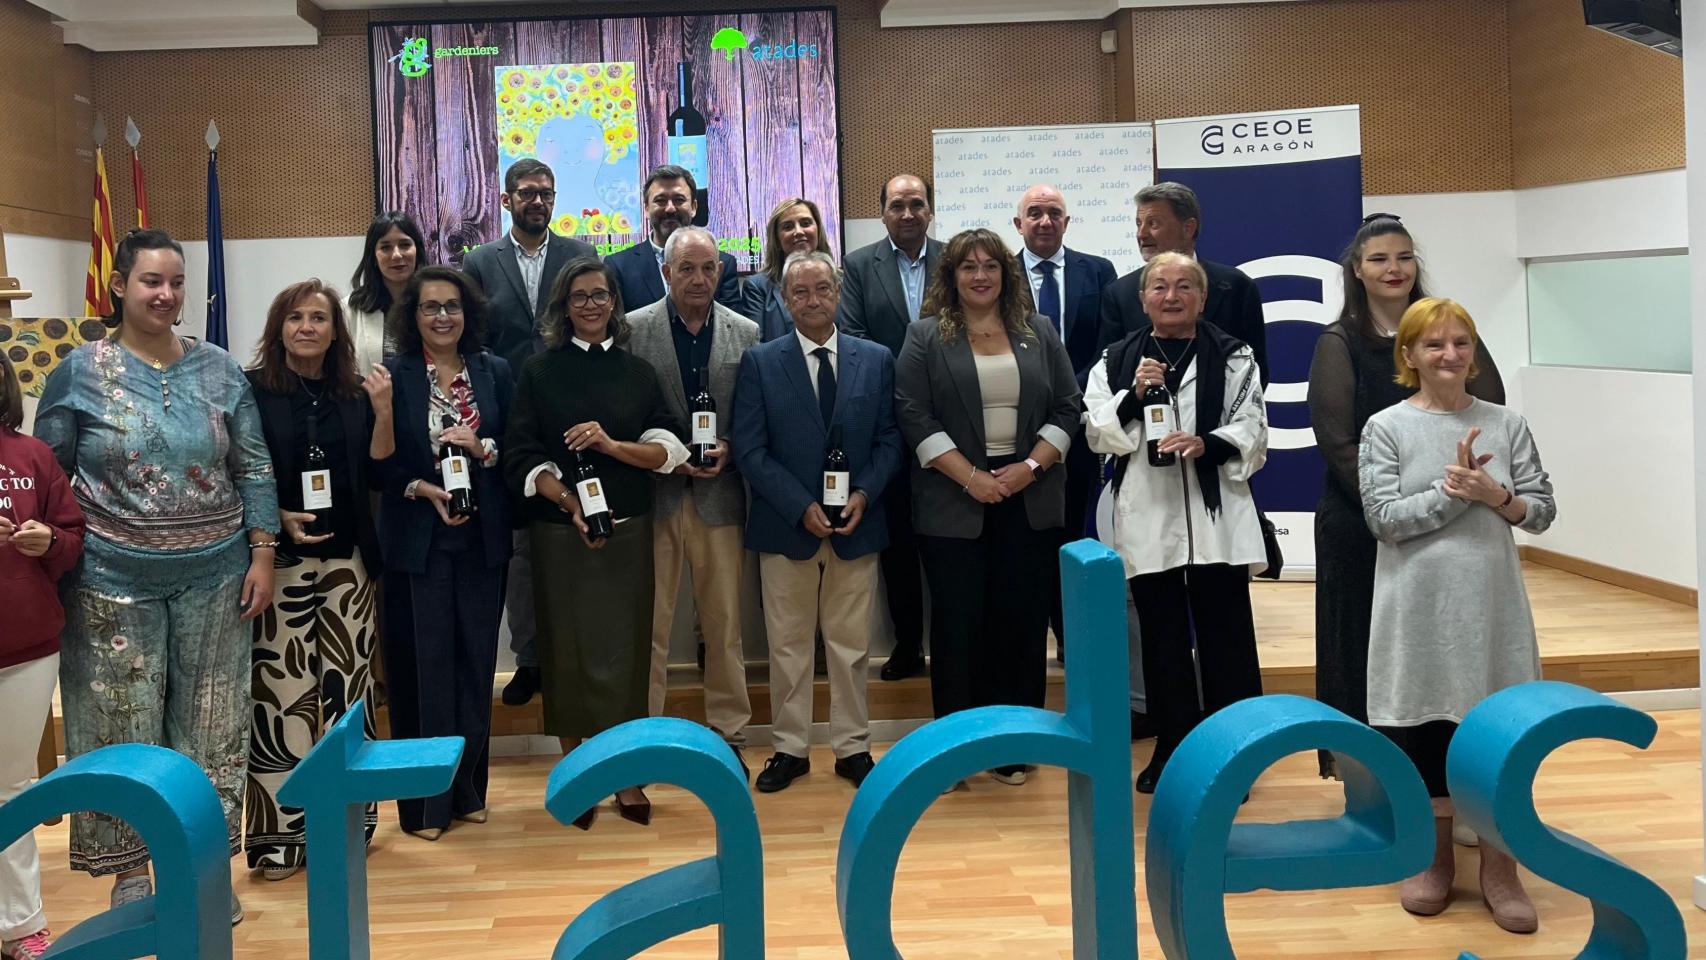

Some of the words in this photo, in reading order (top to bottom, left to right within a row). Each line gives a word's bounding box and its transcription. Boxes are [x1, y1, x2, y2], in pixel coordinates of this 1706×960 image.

[434, 45, 499, 59] gardeniers
[752, 39, 818, 60] atades
[1232, 118, 1312, 138] CEOE
[935, 135, 964, 145] atades
[981, 133, 1011, 143] atades
[1028, 132, 1058, 141] atades
[1074, 130, 1105, 140] atades
[1122, 129, 1152, 138] atades
[958, 151, 988, 161] atades
[1005, 149, 1035, 159] atades
[1052, 148, 1082, 157] atades
[1099, 146, 1129, 156] atades
[1233, 140, 1314, 154] ARAGÓN
[935, 169, 965, 179] atades
[982, 167, 1012, 177] atades
[1029, 165, 1059, 175] atades
[1076, 164, 1106, 173] atades
[1123, 162, 1152, 172] atades
[959, 184, 989, 194] atades
[1100, 180, 1130, 189] atades
[936, 203, 967, 213] atades
[983, 200, 1013, 210] atades
[1077, 198, 1107, 207] atades
[960, 218, 990, 228] atades
[1101, 214, 1131, 223] atades
[718, 236, 761, 253] 2025
[1102, 247, 1132, 256] atades
[0, 537, 1690, 960] atades
